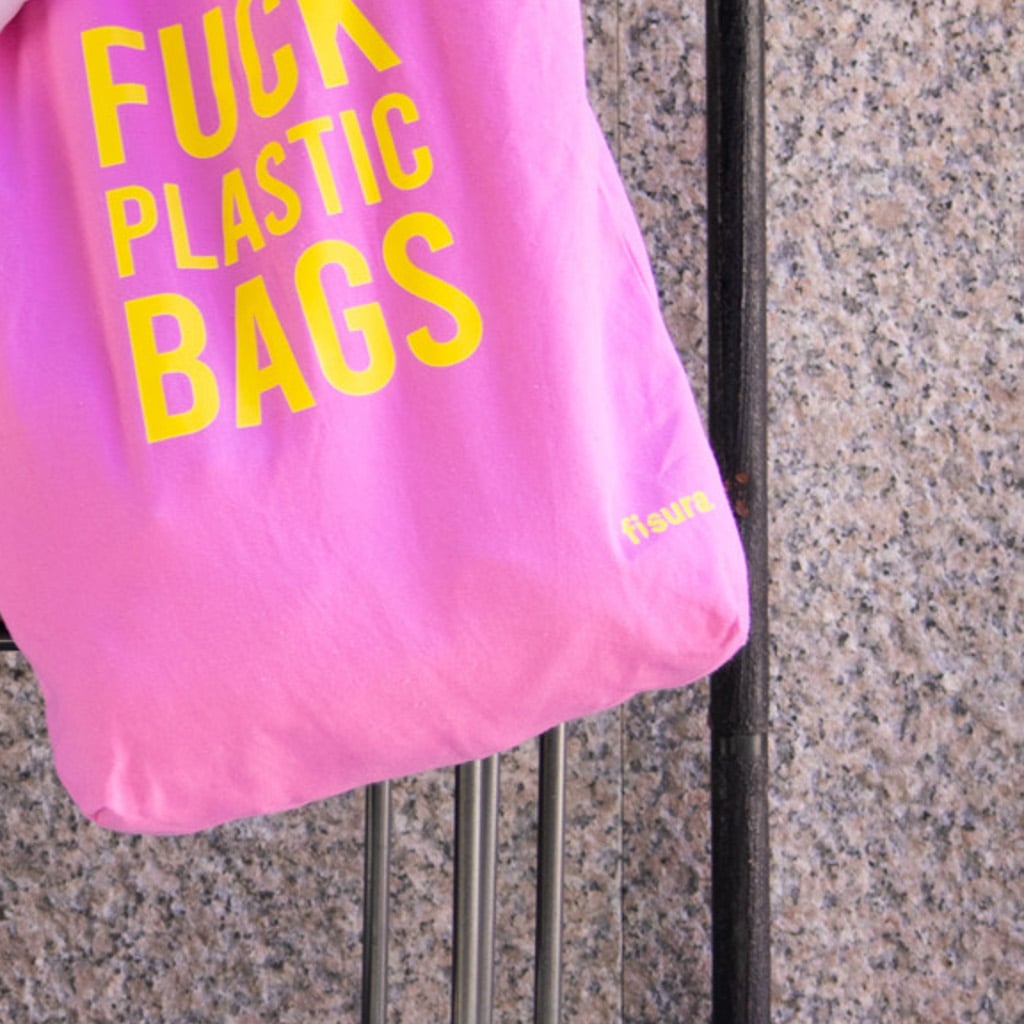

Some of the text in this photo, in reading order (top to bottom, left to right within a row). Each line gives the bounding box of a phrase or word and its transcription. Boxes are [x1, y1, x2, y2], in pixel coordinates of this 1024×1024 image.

[105, 92, 433, 279] PLASTIC
[124, 212, 484, 443] BAGS
[621, 491, 714, 545] fisura
